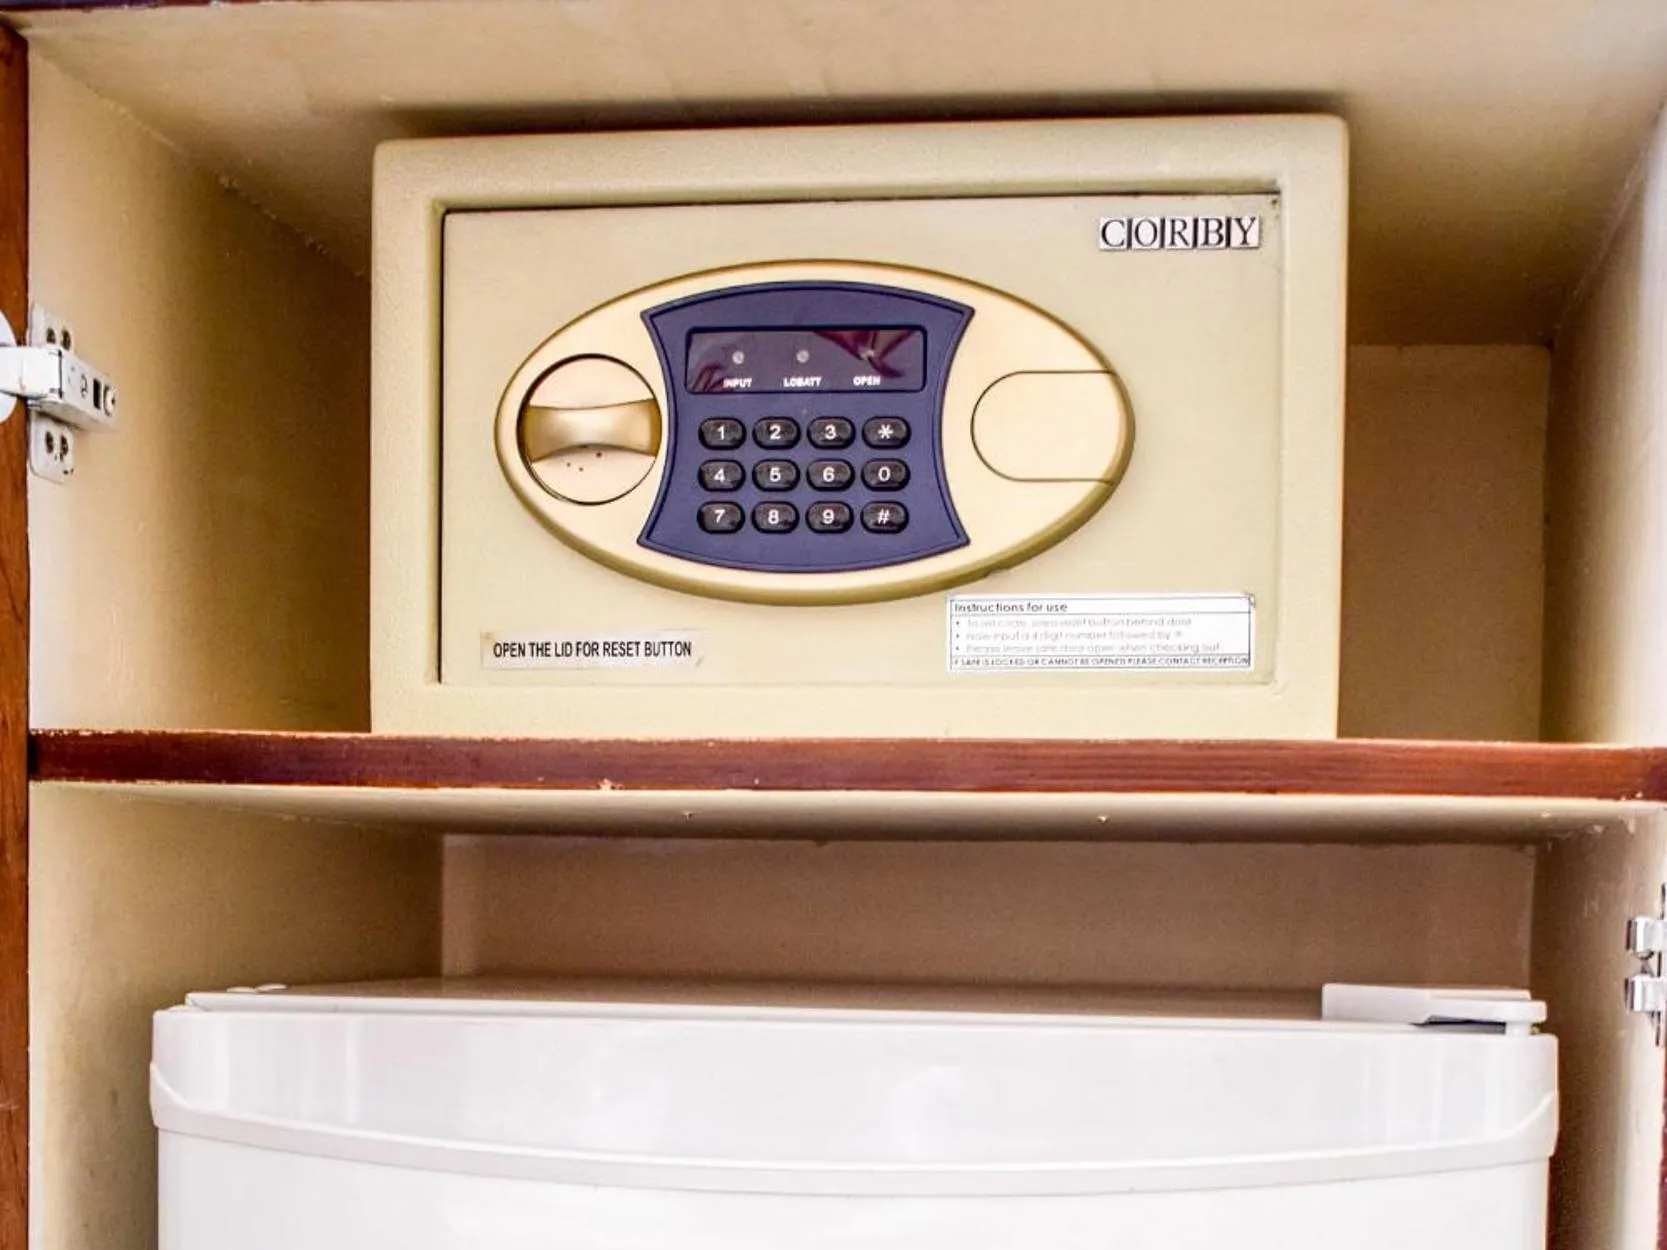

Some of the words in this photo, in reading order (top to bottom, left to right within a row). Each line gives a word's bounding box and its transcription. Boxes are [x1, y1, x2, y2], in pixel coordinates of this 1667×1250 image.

[722, 377, 752, 388] INPUT
[853, 375, 881, 386] OPEN
[717, 425, 725, 441] 1
[769, 423, 782, 441] 2
[824, 424, 837, 440] 3
[713, 467, 726, 483] 4
[769, 466, 782, 483] 5
[822, 466, 835, 483] 6
[877, 466, 891, 482] 0
[713, 508, 726, 524] 7
[767, 509, 780, 525] 8
[822, 508, 835, 525] 9
[954, 602, 1025, 613] Instructions
[1027, 602, 1043, 612] for
[1046, 604, 1068, 612] use
[493, 641, 526, 657] OPEN
[529, 641, 550, 657] THE
[554, 641, 572, 657] LID
[576, 641, 599, 657] FOR
[604, 641, 640, 657] RESET
[644, 641, 692, 657] BUTTON
